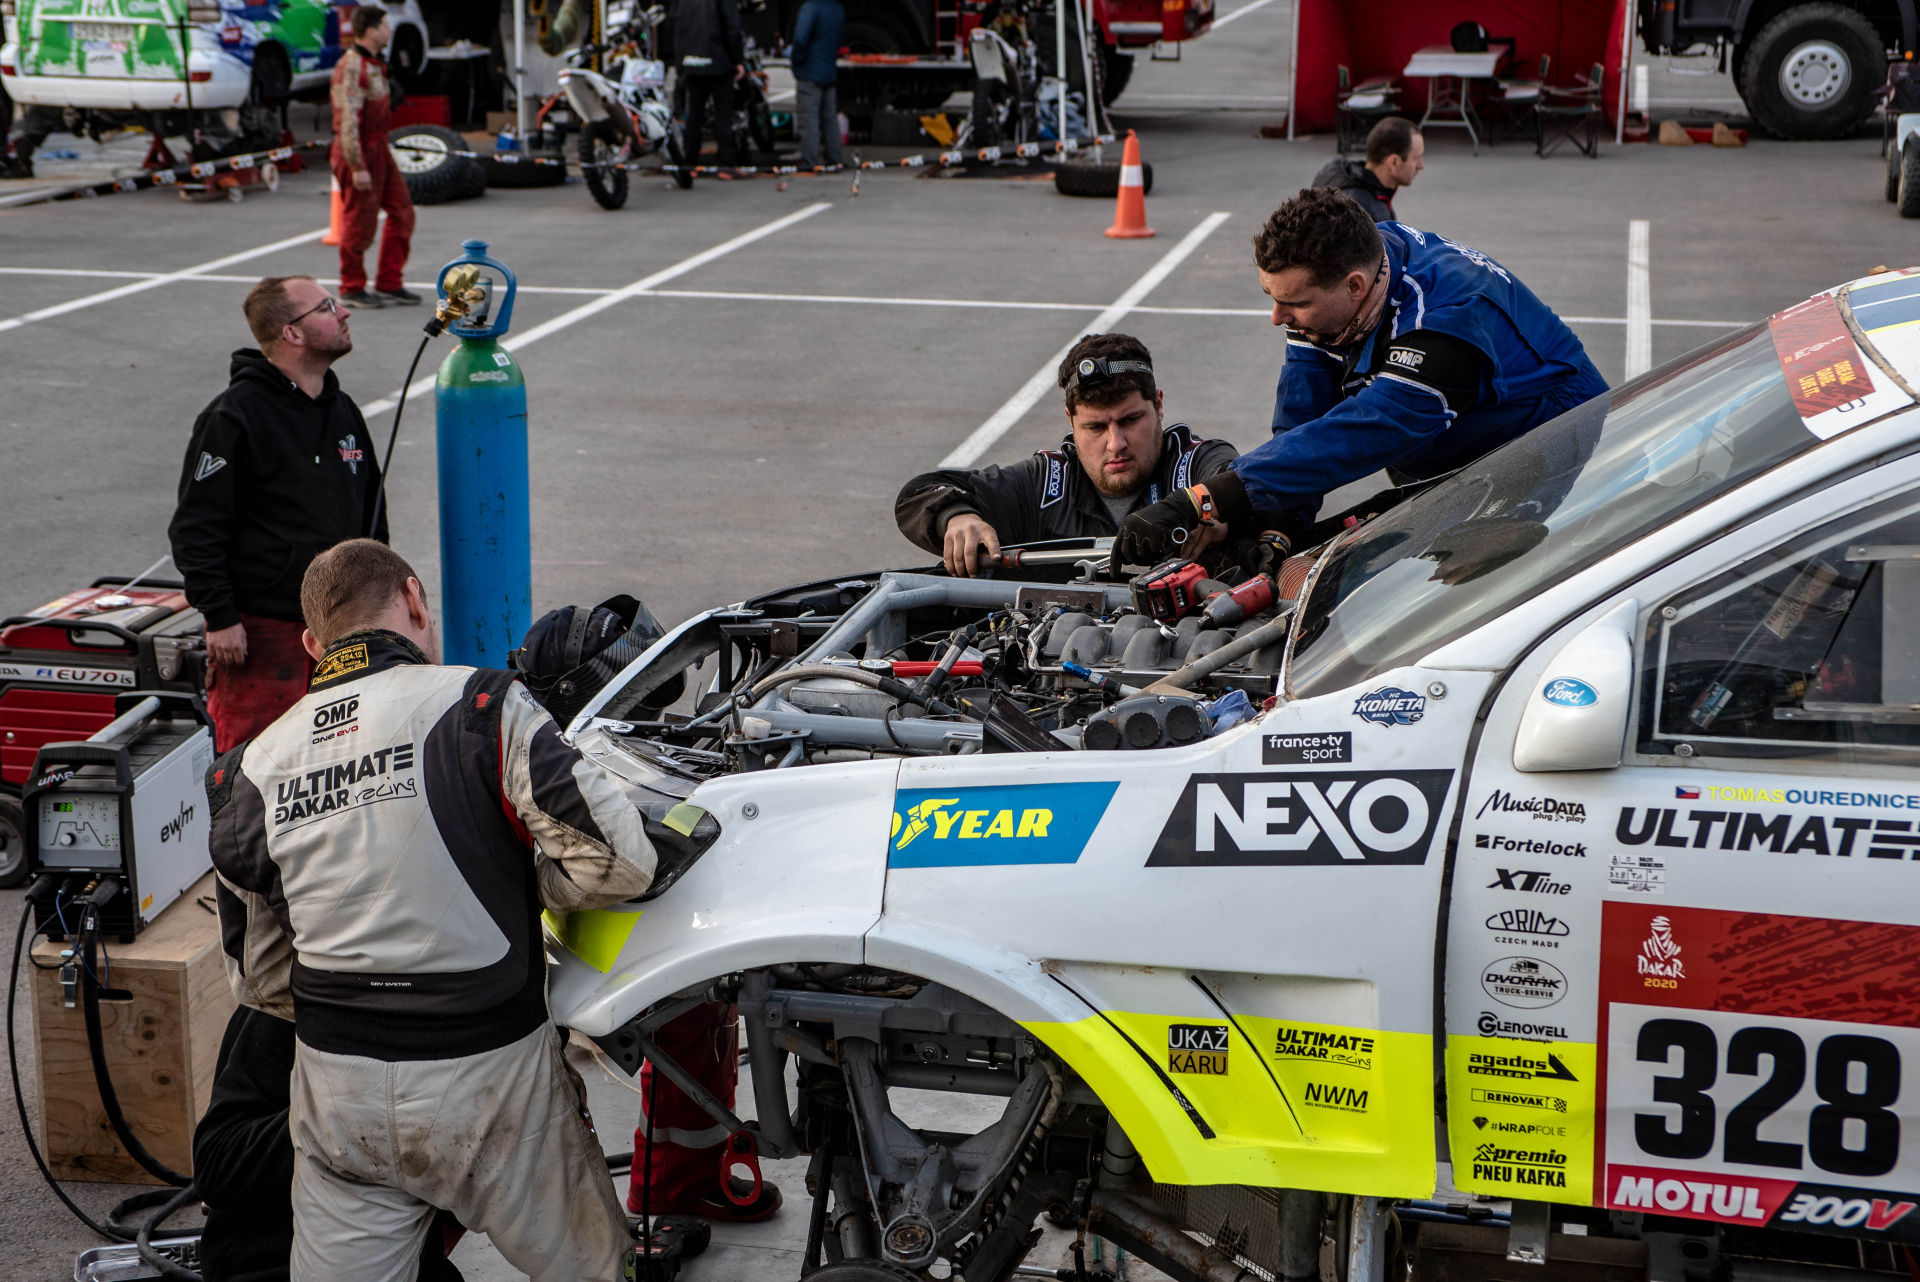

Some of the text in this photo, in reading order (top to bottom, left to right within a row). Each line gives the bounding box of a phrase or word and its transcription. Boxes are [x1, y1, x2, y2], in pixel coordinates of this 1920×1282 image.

[1390, 350, 1424, 367] OMP
[1050, 459, 1062, 496] sparco
[1547, 680, 1585, 704] Ford
[313, 699, 359, 728] OMP
[1355, 697, 1425, 714] KOMETA
[1302, 747, 1343, 763] sport
[277, 743, 414, 805] ULTIMATE
[275, 776, 417, 826] DAKAR racing
[1475, 789, 1586, 820] MusicDATA
[160, 802, 195, 843] ewm
[1195, 777, 1429, 860] NEXO
[1533, 812, 1553, 822] plug
[1566, 815, 1586, 824] play
[1615, 806, 1914, 860] ULTIMATE
[1491, 836, 1588, 858] Fortelock
[1486, 868, 1572, 895] XTline
[1499, 909, 1558, 935] PRIM
[1494, 936, 1560, 949] CZECH MADE
[1637, 954, 1686, 978] DAKAR
[1494, 985, 1554, 998] TRUCK-SERVIS
[1644, 977, 1678, 989] 2020
[1169, 1027, 1228, 1050] UKAŽ
[1276, 1028, 1374, 1053] ULTIMATE
[1169, 1051, 1227, 1074] KÁRU
[1275, 1043, 1328, 1059] DAKAR
[1469, 1053, 1547, 1070] agados
[1470, 1067, 1531, 1079] TRAILERS
[1304, 1082, 1368, 1108] NWM
[1487, 1092, 1544, 1106] RENOVAK
[1634, 1018, 1902, 1177] 328
[1490, 1121, 1567, 1137] #WRAPFOLIE
[1492, 1147, 1567, 1165] premio
[1473, 1163, 1567, 1188] PNEU KAFKA
[1613, 1175, 1918, 1231] MOTUL 300V
